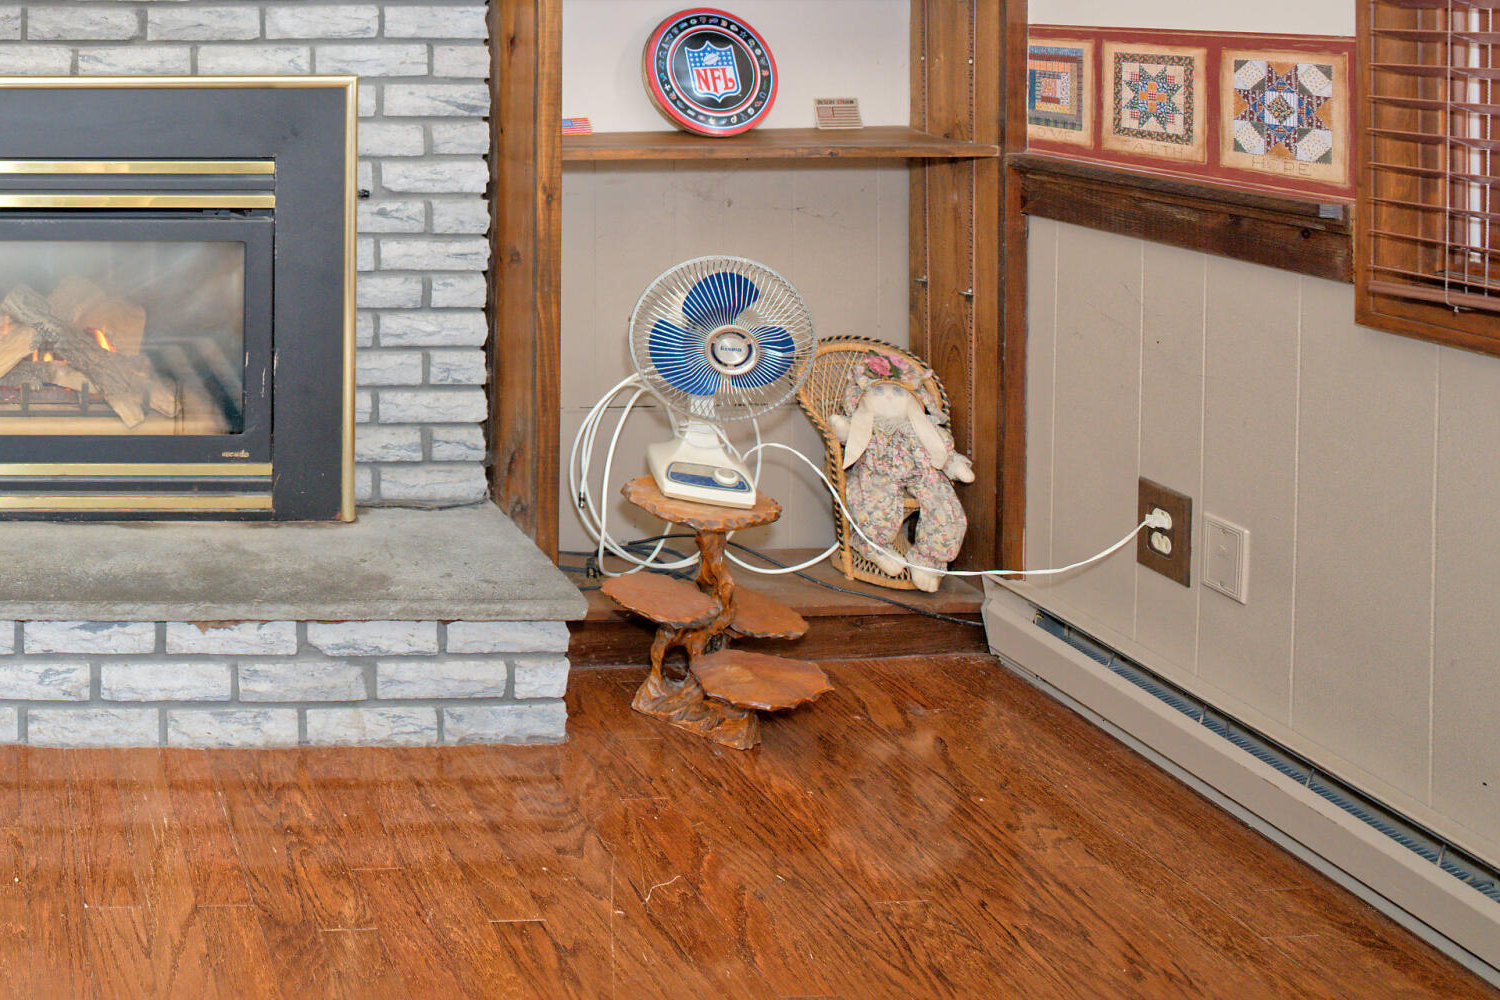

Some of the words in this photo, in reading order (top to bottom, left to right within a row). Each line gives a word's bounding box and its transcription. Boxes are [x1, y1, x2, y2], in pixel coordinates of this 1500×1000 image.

[693, 67, 736, 94] NFL
[1036, 126, 1074, 142] OVE
[1122, 140, 1184, 160] FAITH
[1251, 155, 1312, 177] HOPE
